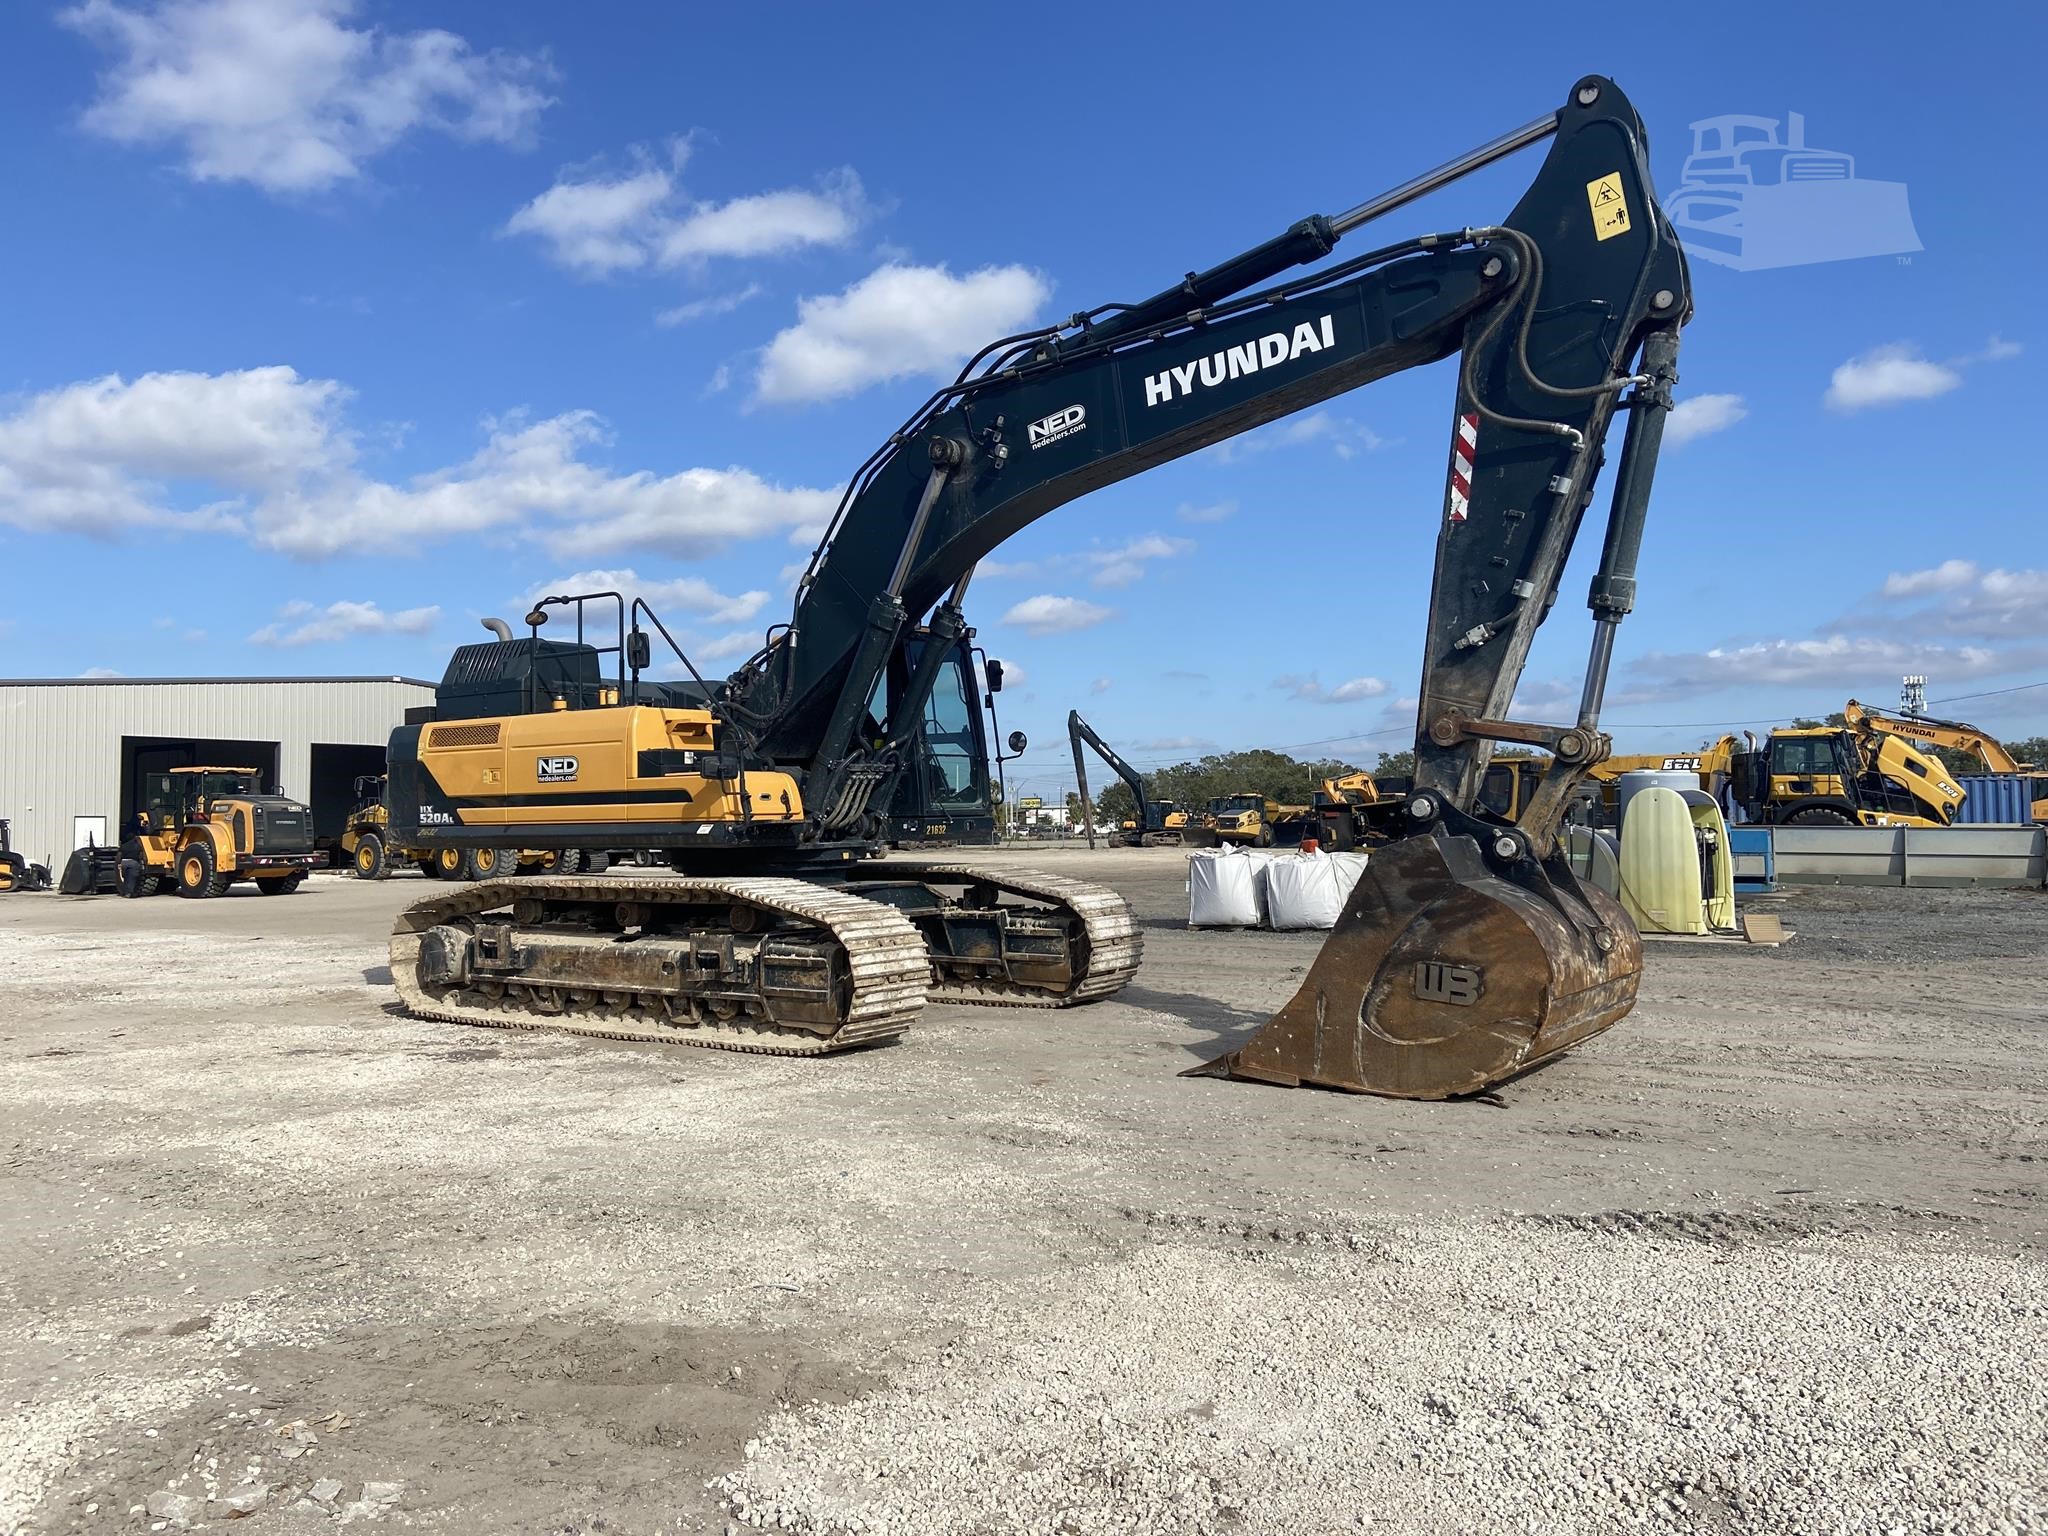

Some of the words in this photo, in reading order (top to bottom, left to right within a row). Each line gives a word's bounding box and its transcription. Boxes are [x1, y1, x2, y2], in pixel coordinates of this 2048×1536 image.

[1144, 314, 1336, 407] HYUNDAI
[1029, 406, 1084, 441] NED
[1032, 422, 1087, 450] nedealers.com
[1892, 724, 1936, 738] HYUNDAI
[538, 758, 578, 774] NED
[1662, 758, 1701, 770] BELL
[926, 825, 947, 835] 21632
